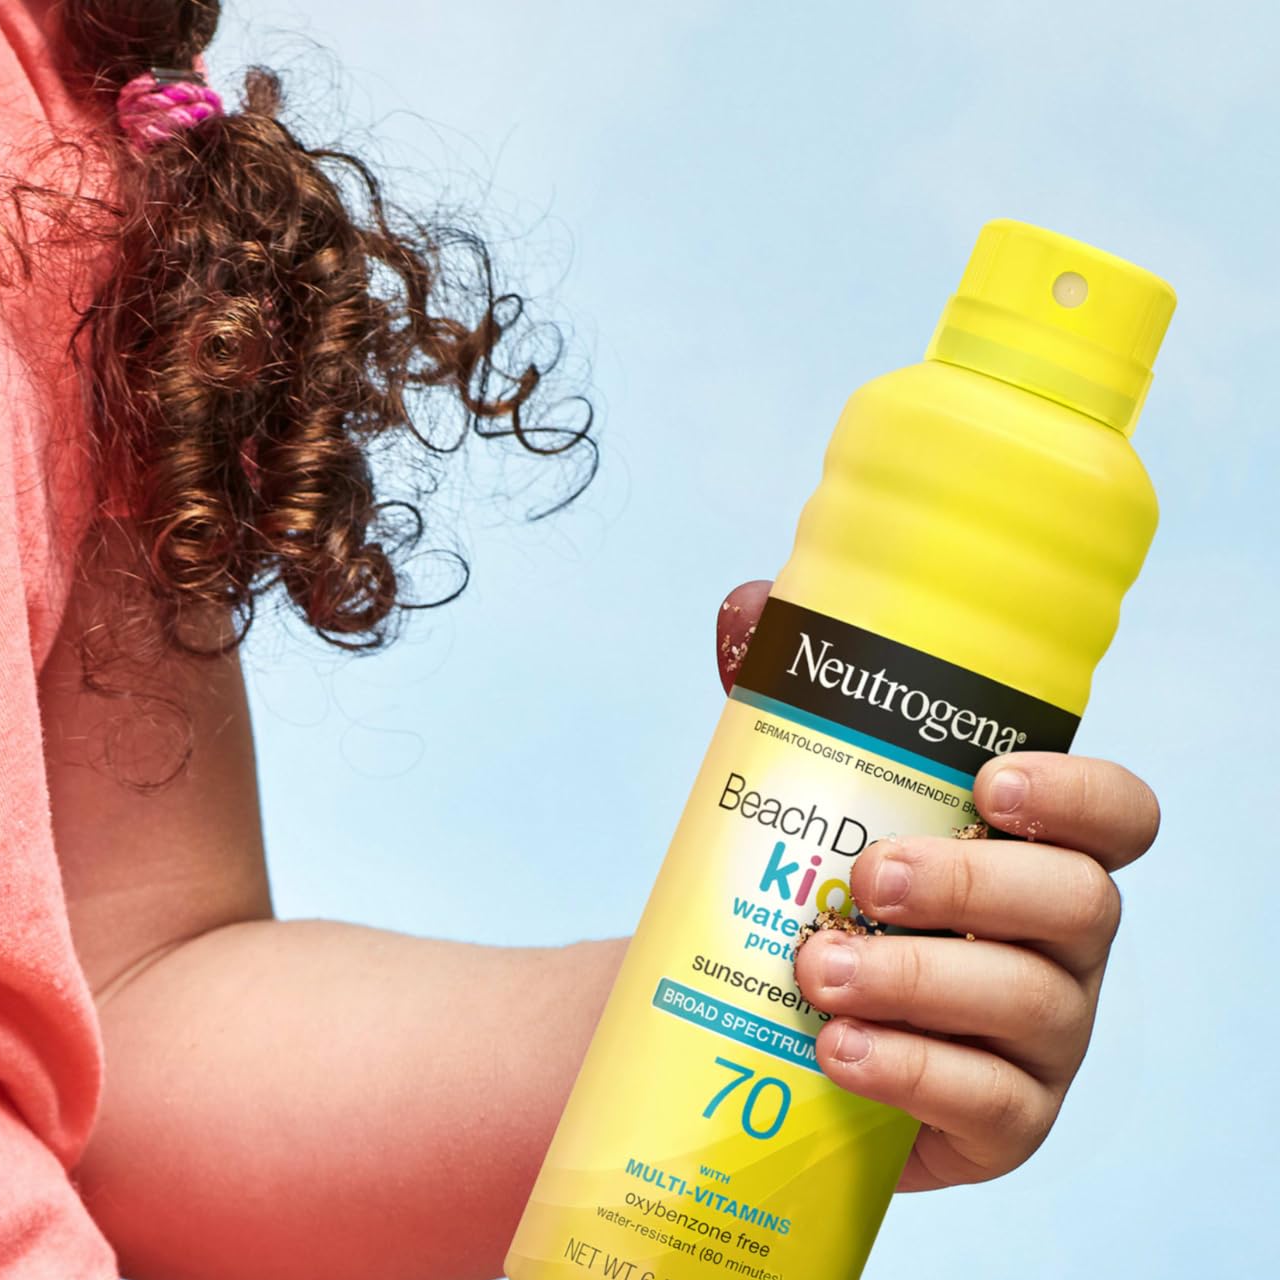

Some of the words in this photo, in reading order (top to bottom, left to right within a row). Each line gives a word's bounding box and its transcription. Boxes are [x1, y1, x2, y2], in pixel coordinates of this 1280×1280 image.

[753, 720, 853, 766] DERMATOLOGIST
[854, 759, 960, 808] RECOMMENDED
[962, 801, 980, 817] BR
[718, 773, 828, 847] Beach
[732, 897, 799, 937] wate
[663, 986, 718, 1021] BROAD
[721, 1012, 816, 1062] SPECTRUM
[702, 1056, 792, 1140] 70
[625, 1158, 792, 1235] MULTI-VITAMINS
[699, 1164, 731, 1185] WITH
[564, 1237, 602, 1269] NET
[596, 1206, 696, 1257] water-resistant
[698, 1246, 723, 1266] (80
[625, 1192, 732, 1245] oxybenzone
[737, 1234, 771, 1258] free
